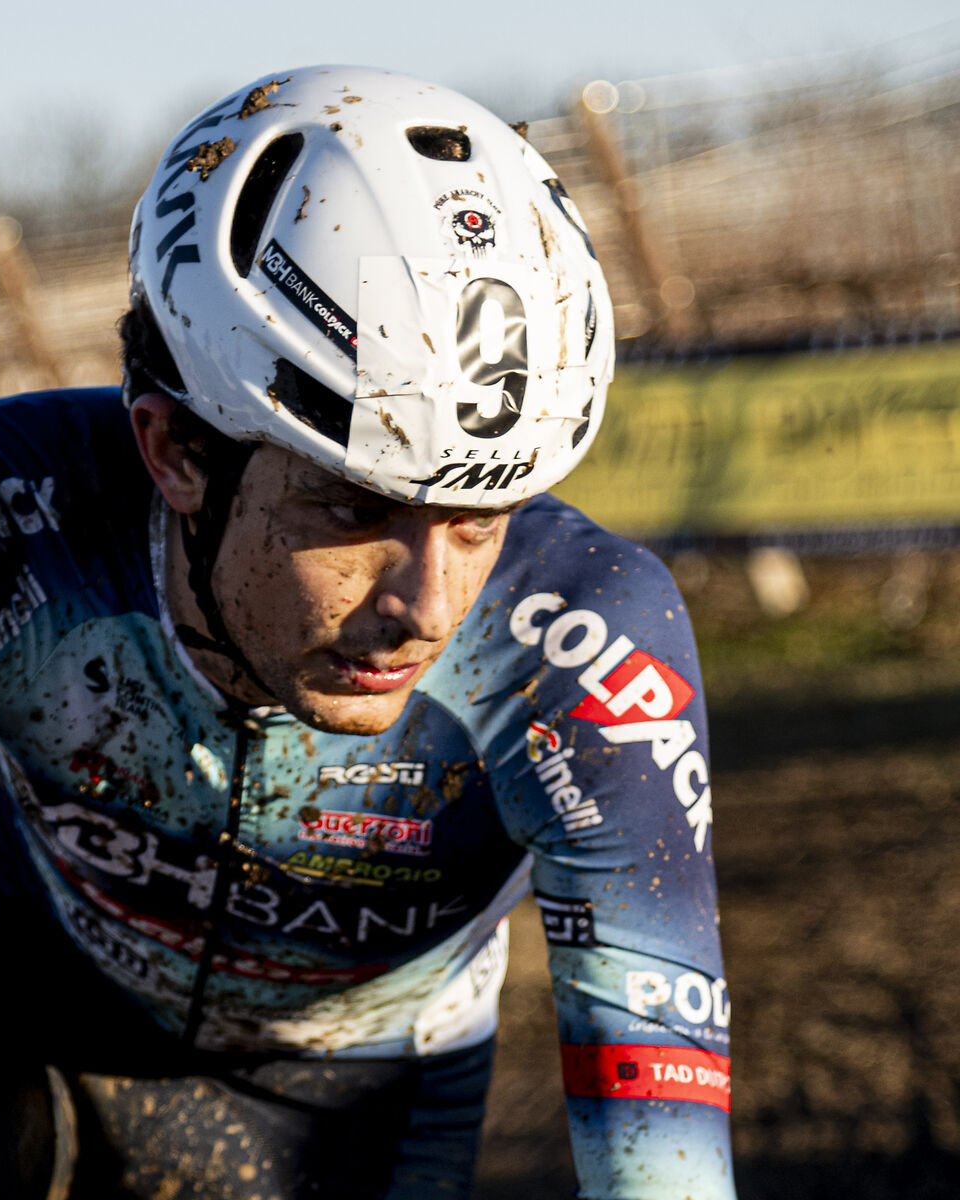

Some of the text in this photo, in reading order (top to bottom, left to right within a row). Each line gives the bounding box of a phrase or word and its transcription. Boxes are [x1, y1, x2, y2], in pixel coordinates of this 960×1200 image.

[285, 273, 319, 308] BANK
[313, 303, 352, 340] COLPACK
[456, 277, 528, 439] 9
[409, 462, 535, 490] SMP
[509, 592, 713, 853] COLPACK
[225, 880, 468, 943] BANK
[650, 1063, 694, 1083] TAD
